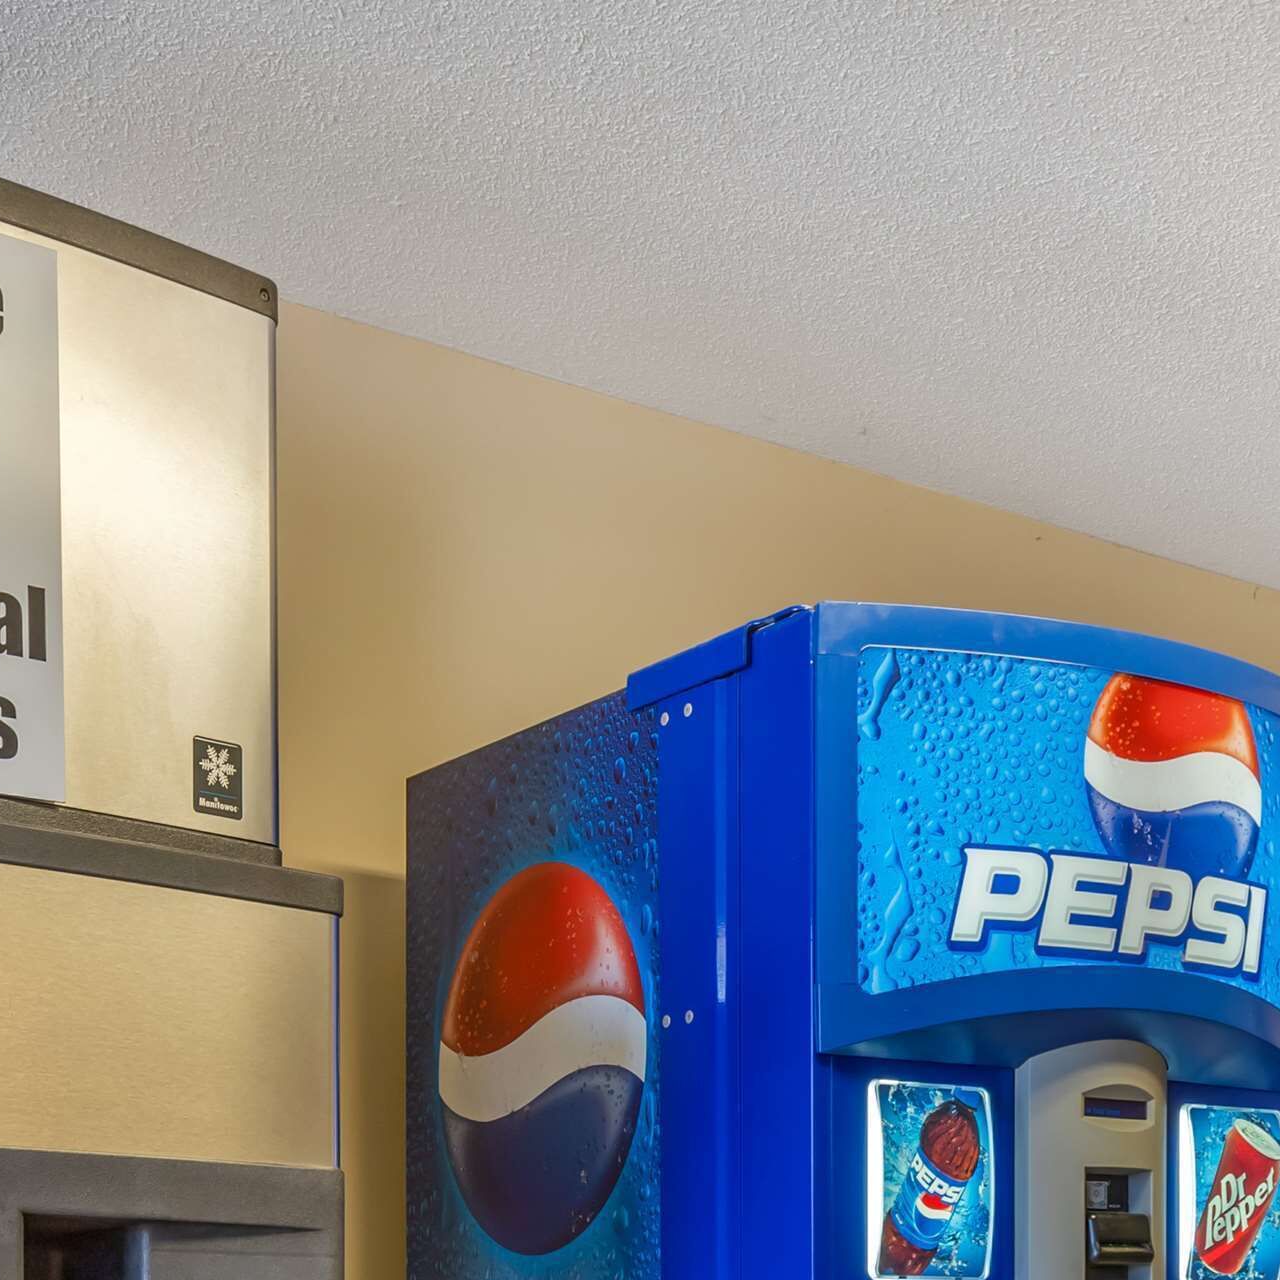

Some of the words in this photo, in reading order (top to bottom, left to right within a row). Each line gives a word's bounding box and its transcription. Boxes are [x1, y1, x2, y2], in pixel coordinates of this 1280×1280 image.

[949, 845, 1268, 976] PEPSI
[1205, 1167, 1276, 1250] Pepper
[1220, 1172, 1247, 1213] Dr
